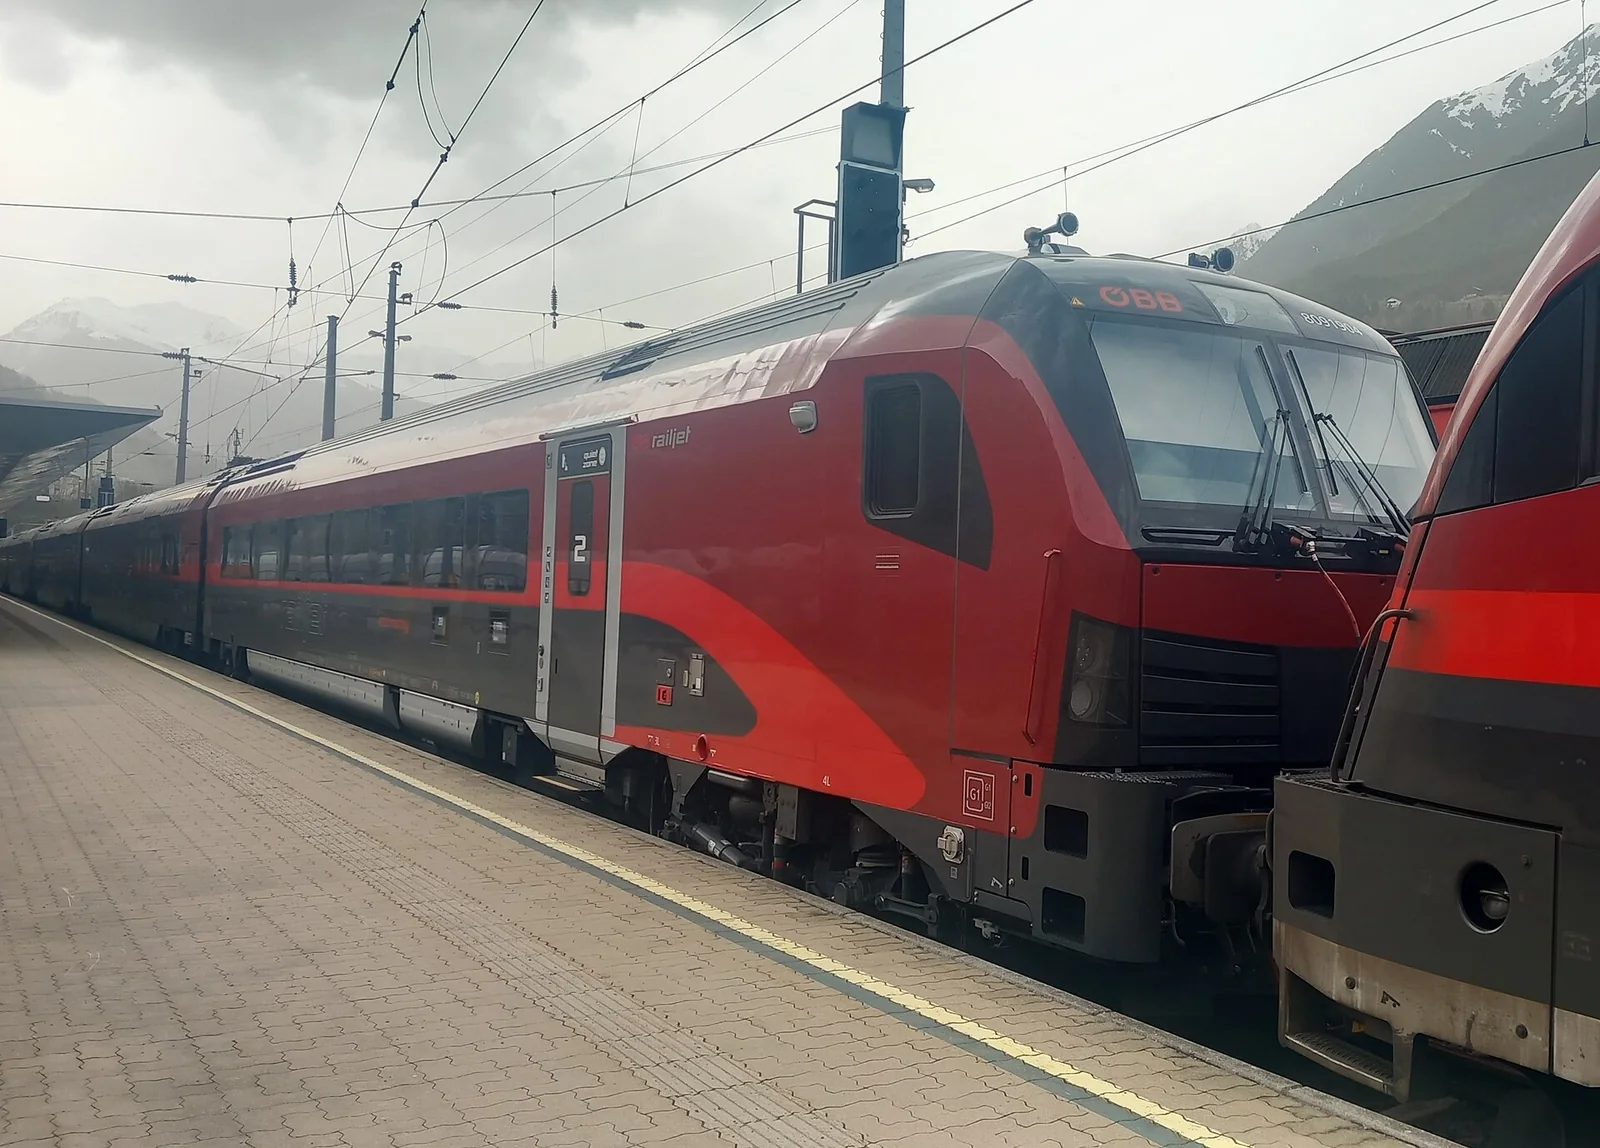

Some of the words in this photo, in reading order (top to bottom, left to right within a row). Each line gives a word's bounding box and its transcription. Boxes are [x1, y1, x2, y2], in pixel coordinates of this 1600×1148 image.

[1099, 285, 1183, 312] ÖBB
[652, 425, 691, 449] railjet
[574, 535, 587, 562] 2
[822, 775, 831, 787] 4L
[969, 788, 980, 801] G1
